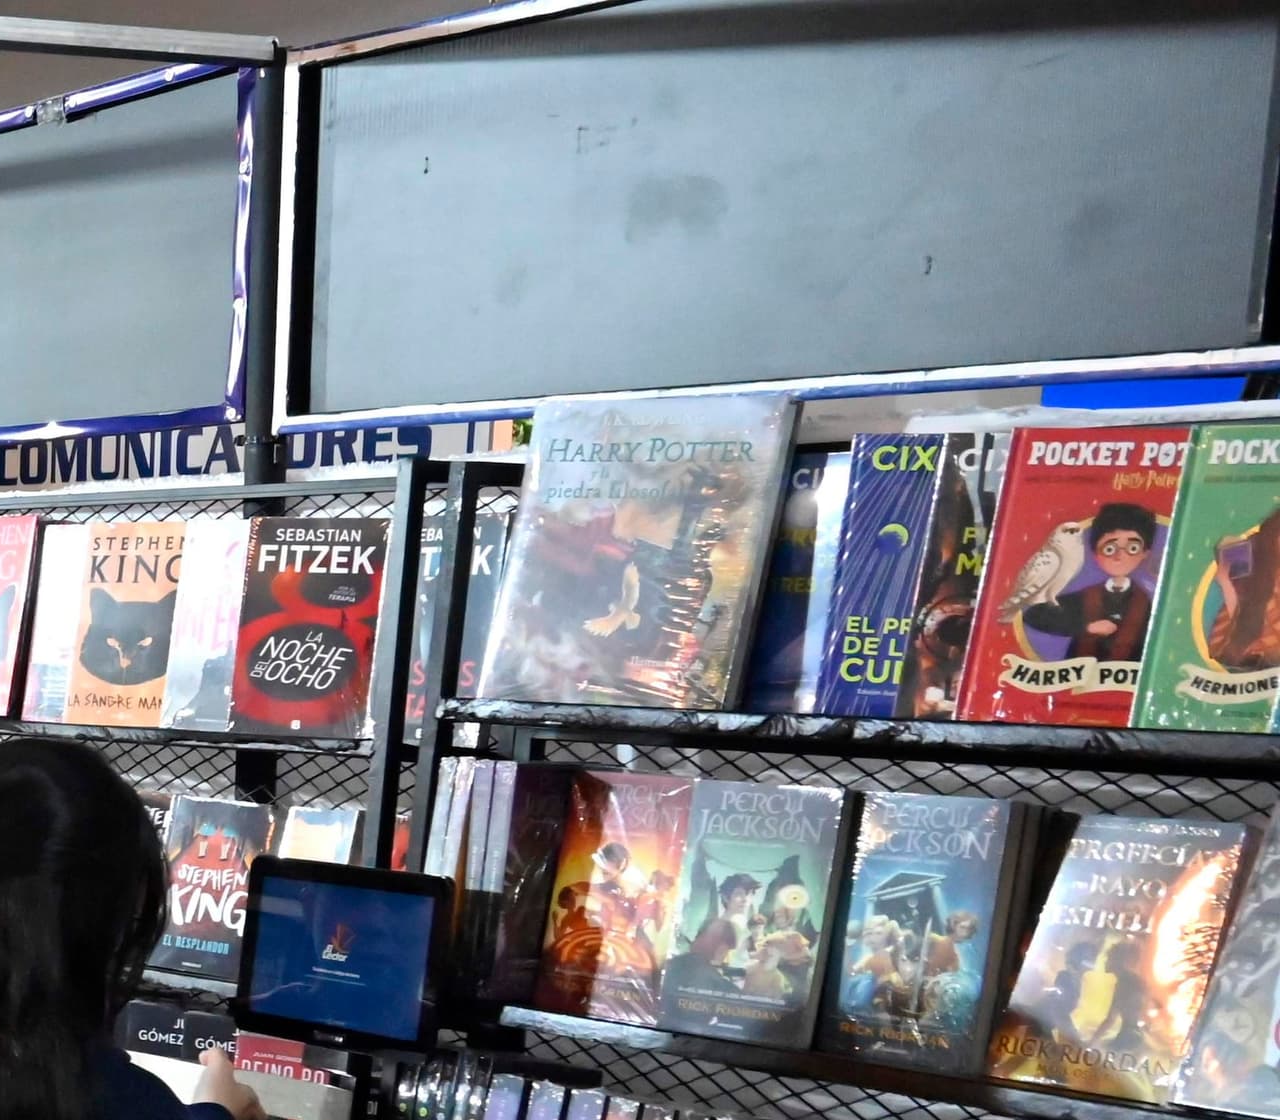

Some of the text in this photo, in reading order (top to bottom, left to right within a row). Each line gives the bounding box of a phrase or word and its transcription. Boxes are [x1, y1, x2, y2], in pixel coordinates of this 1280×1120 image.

[545, 437, 756, 463] HARRY POTTER
[872, 445, 937, 472] CIX
[1027, 440, 1134, 467] POCKET
[544, 481, 602, 503] piedra
[276, 527, 363, 544] SEBASTIAN
[258, 545, 377, 576] FITZEK
[846, 616, 874, 633] EL
[304, 630, 324, 644] LA
[842, 636, 878, 656] DE
[259, 635, 354, 672] NOCHE
[250, 657, 273, 679] DEL
[263, 659, 338, 691] OCHO
[1010, 664, 1086, 687] HARRY
[1190, 675, 1279, 697] HERMIONE
[67, 694, 80, 708] LA
[85, 693, 132, 709] SANGRE
[719, 789, 804, 816] PERCY
[697, 808, 827, 844] JACKSON
[882, 802, 973, 831] PERCY
[177, 863, 248, 892] STEPHEN
[162, 934, 229, 956] EL RESPLANDOR
[137, 1028, 184, 1047] GÓMEZ
[996, 1034, 1049, 1059] RICK
